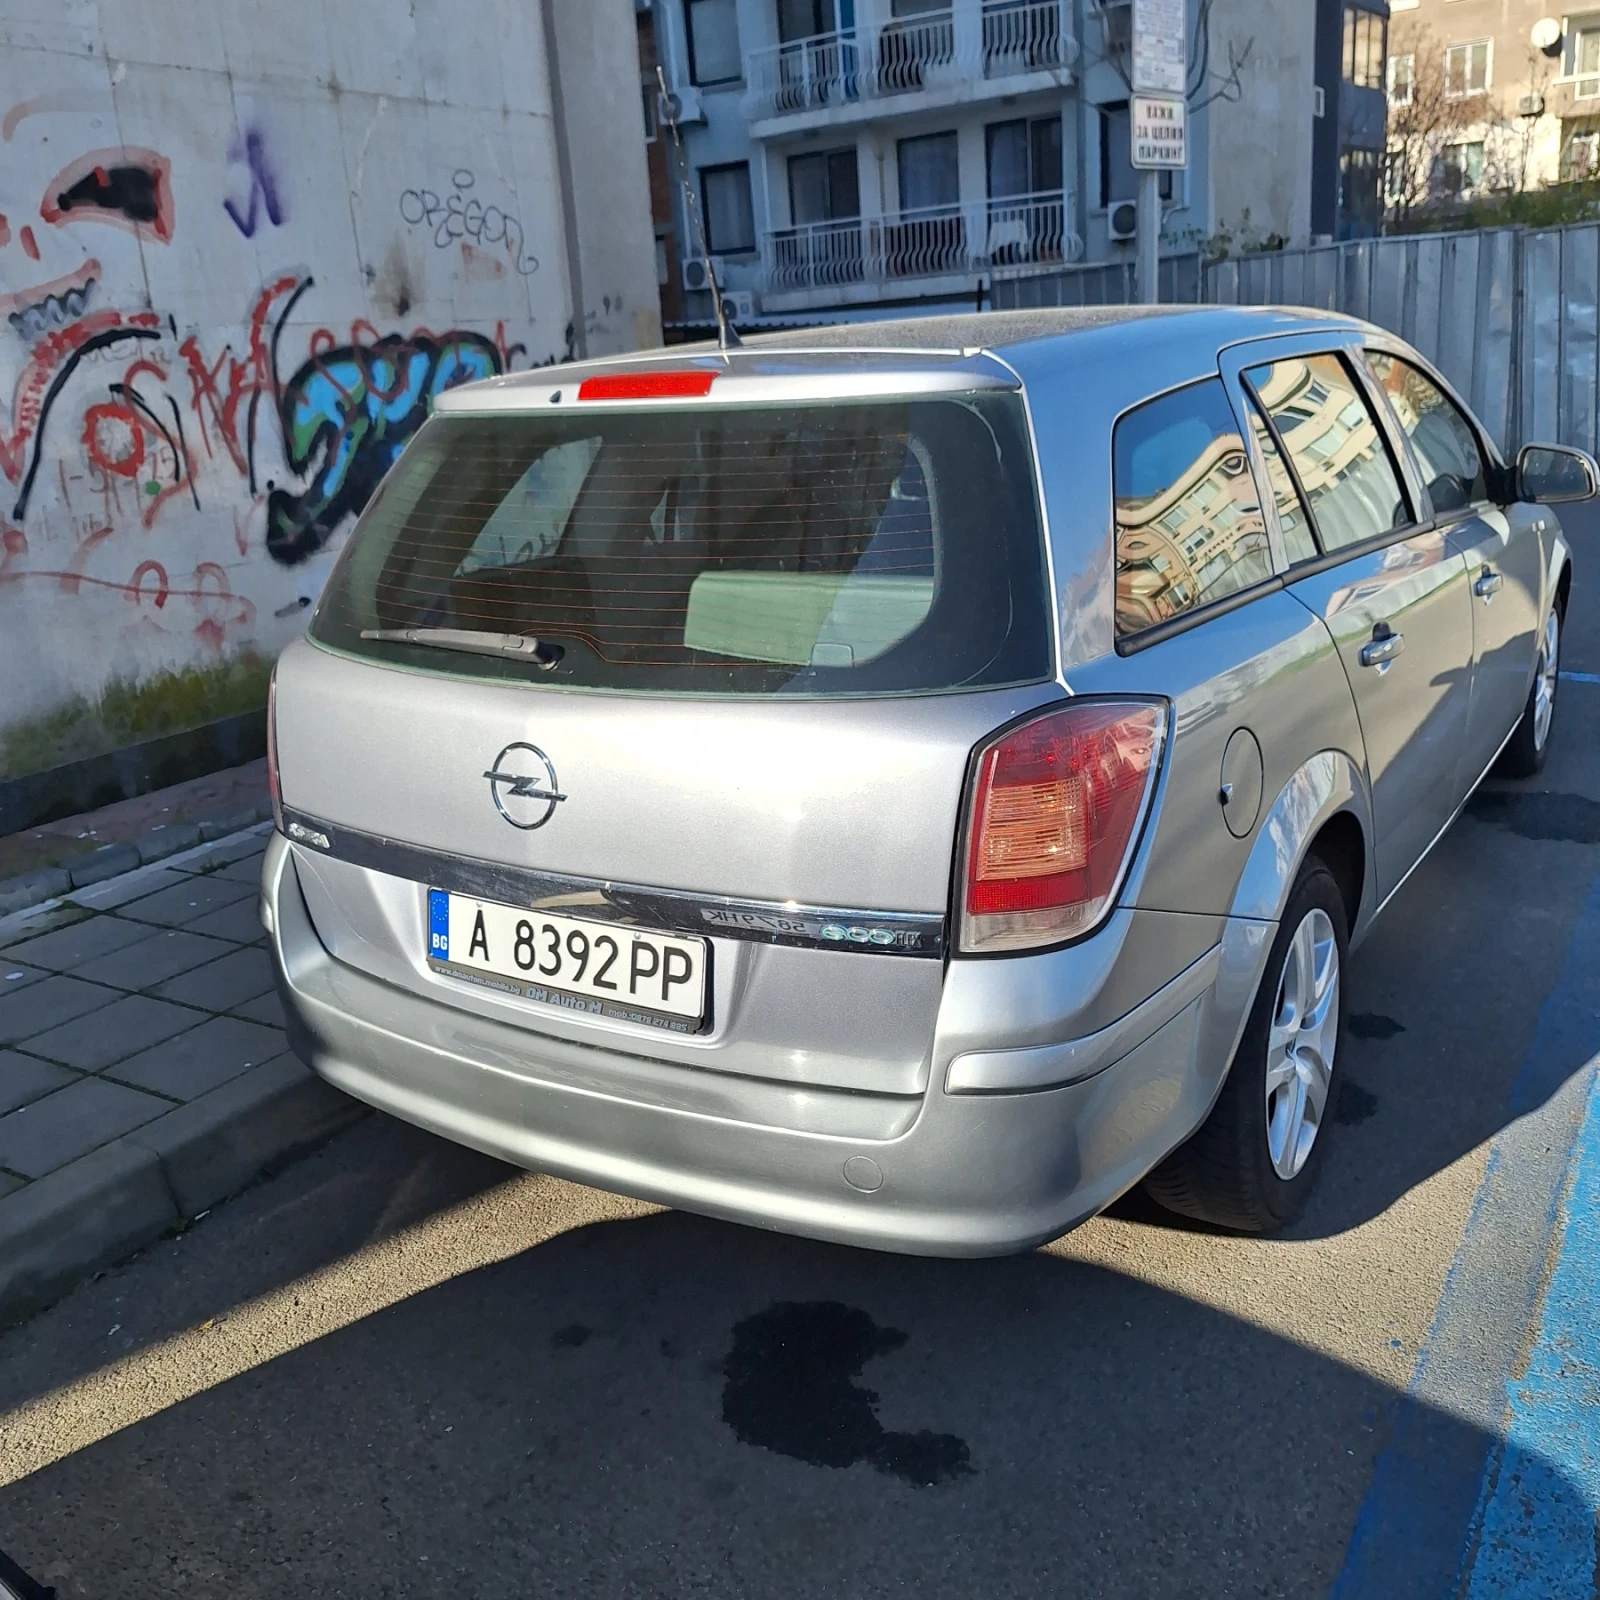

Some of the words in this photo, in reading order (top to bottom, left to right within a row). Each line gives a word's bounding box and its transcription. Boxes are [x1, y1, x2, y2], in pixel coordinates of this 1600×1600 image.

[1138, 145, 1182, 159] ПАРКИНГ
[432, 932, 448, 950] BG
[468, 909, 490, 962] A
[526, 986, 548, 1002] DM
[550, 994, 586, 1011] Auto
[588, 1000, 604, 1015] M
